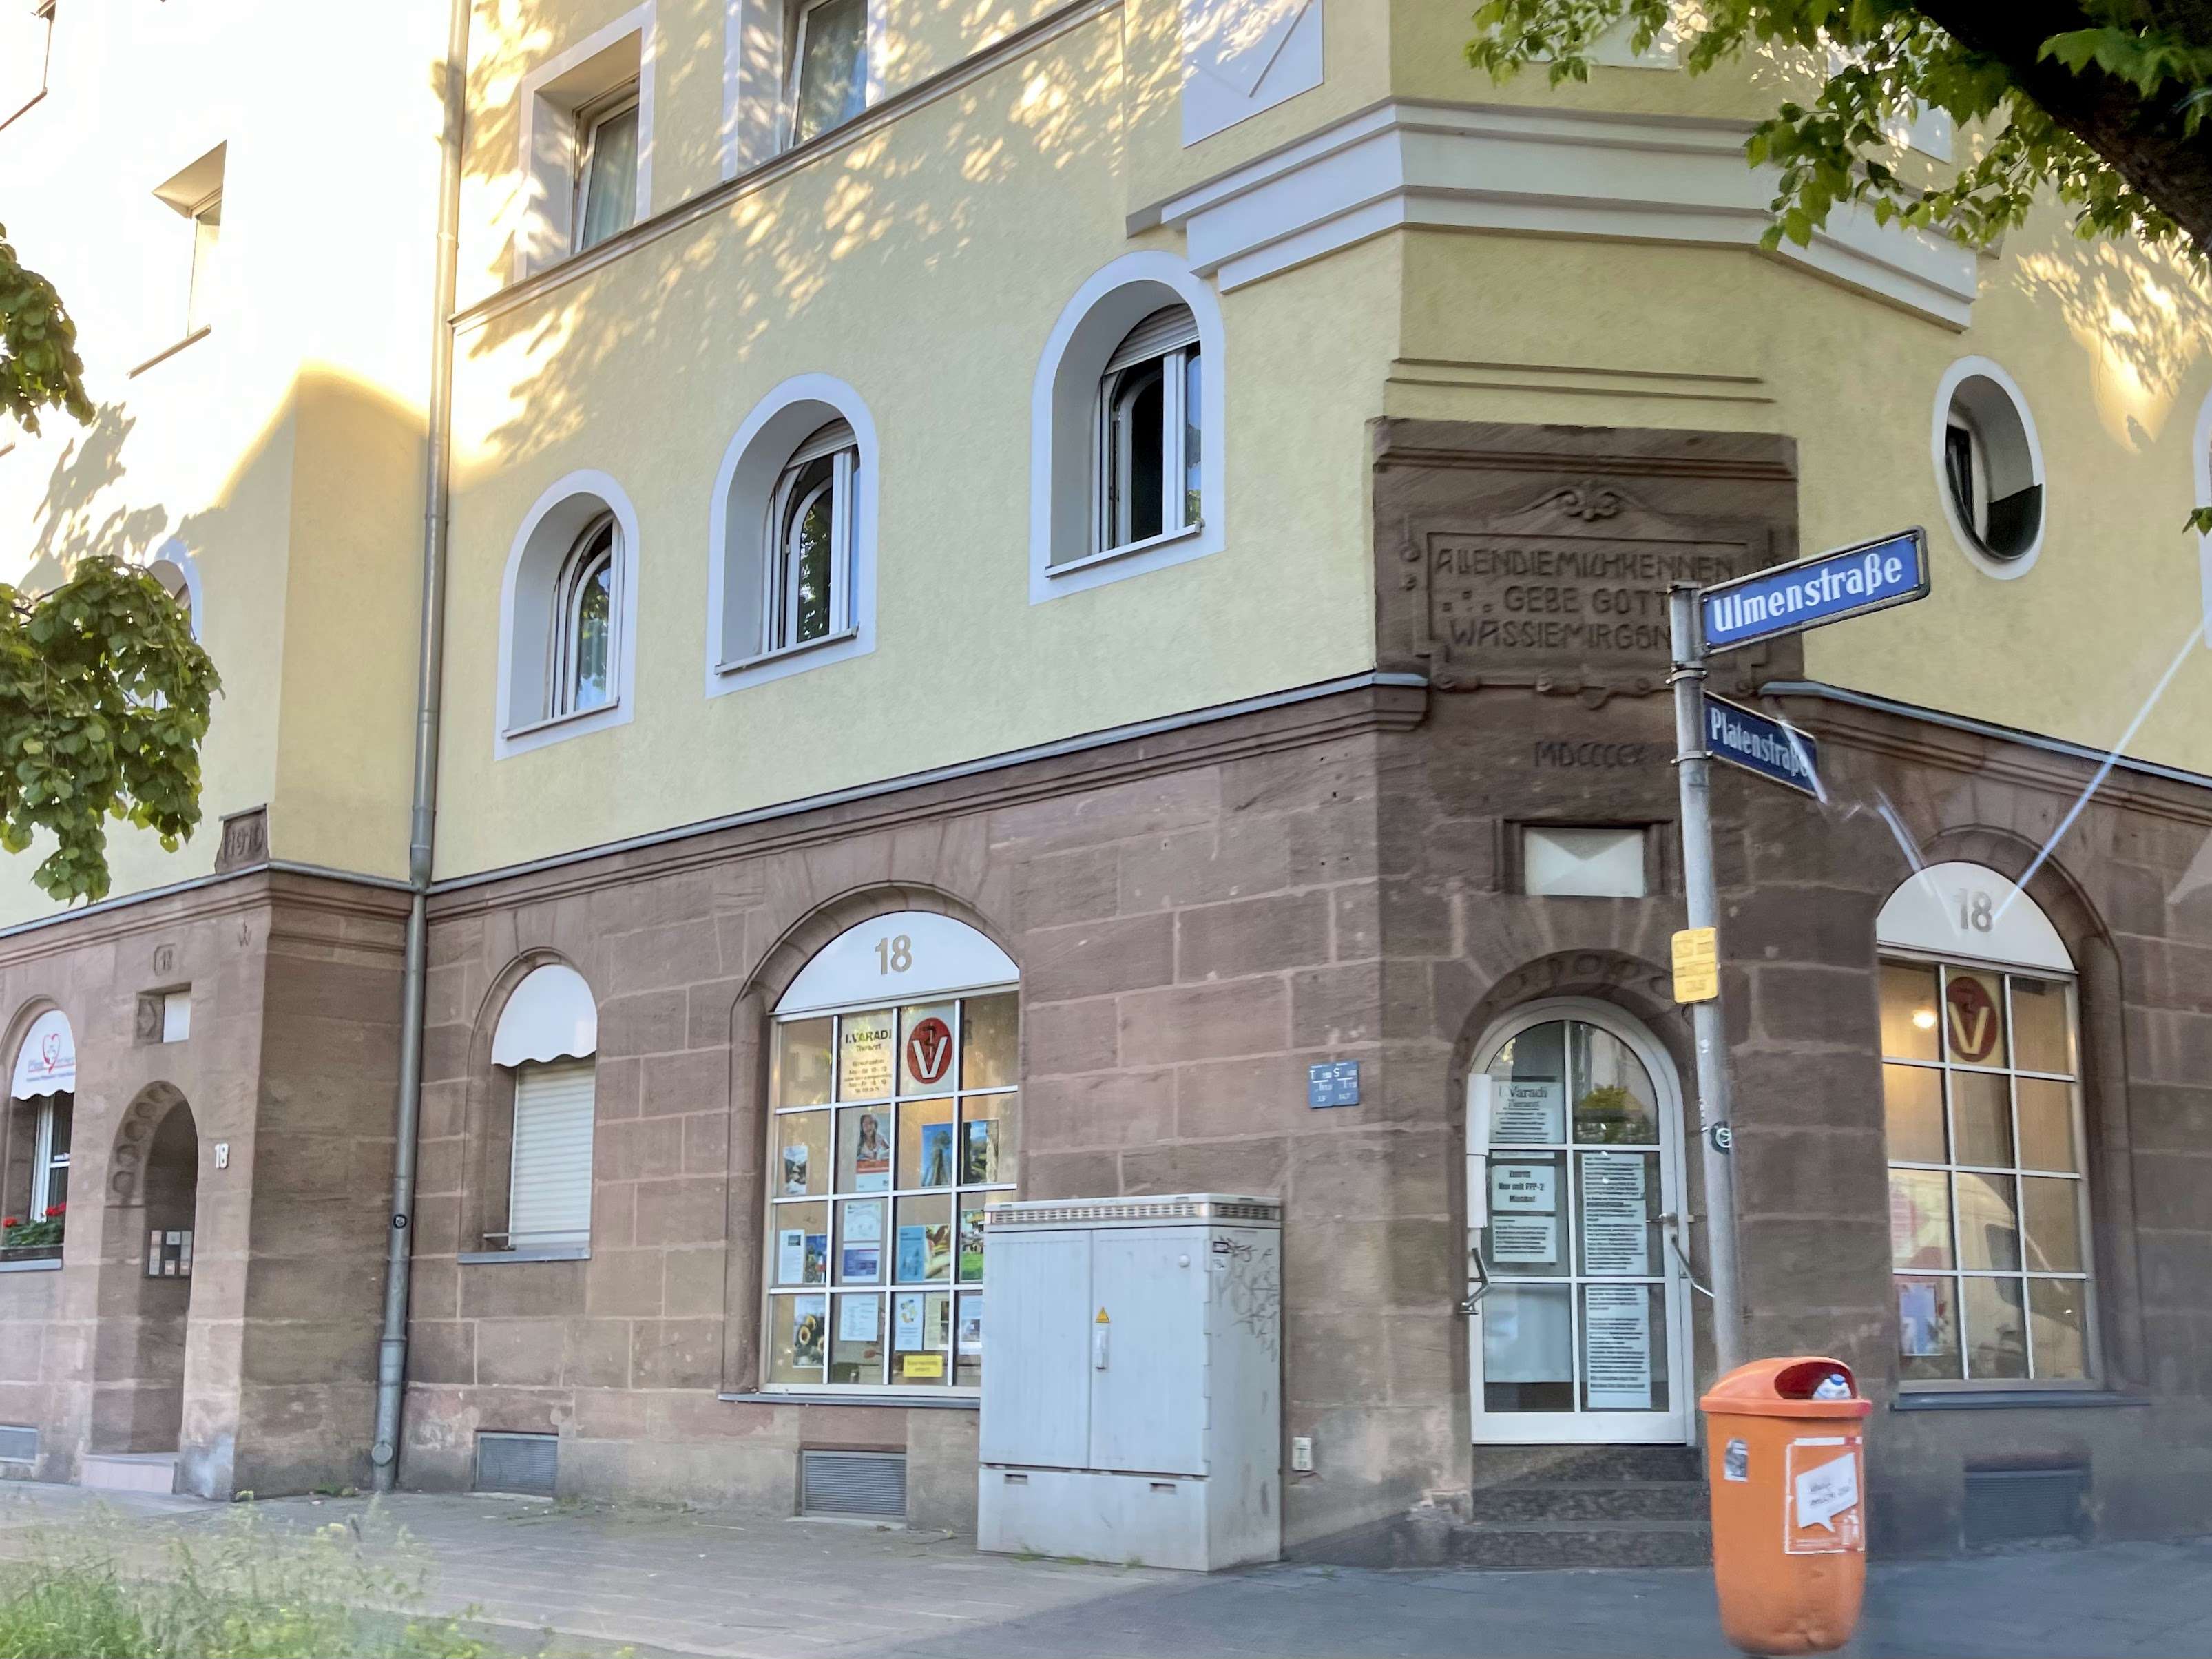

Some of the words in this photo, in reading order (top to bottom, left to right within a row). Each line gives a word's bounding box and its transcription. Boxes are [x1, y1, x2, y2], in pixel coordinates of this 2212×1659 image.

[1503, 585, 1580, 614] GEBE
[1713, 553, 1903, 632] Ulmenstraße
[1953, 888, 1994, 933] 18
[875, 935, 913, 976] 18
[912, 1036, 948, 1079] V
[214, 1143, 229, 1169] 18
